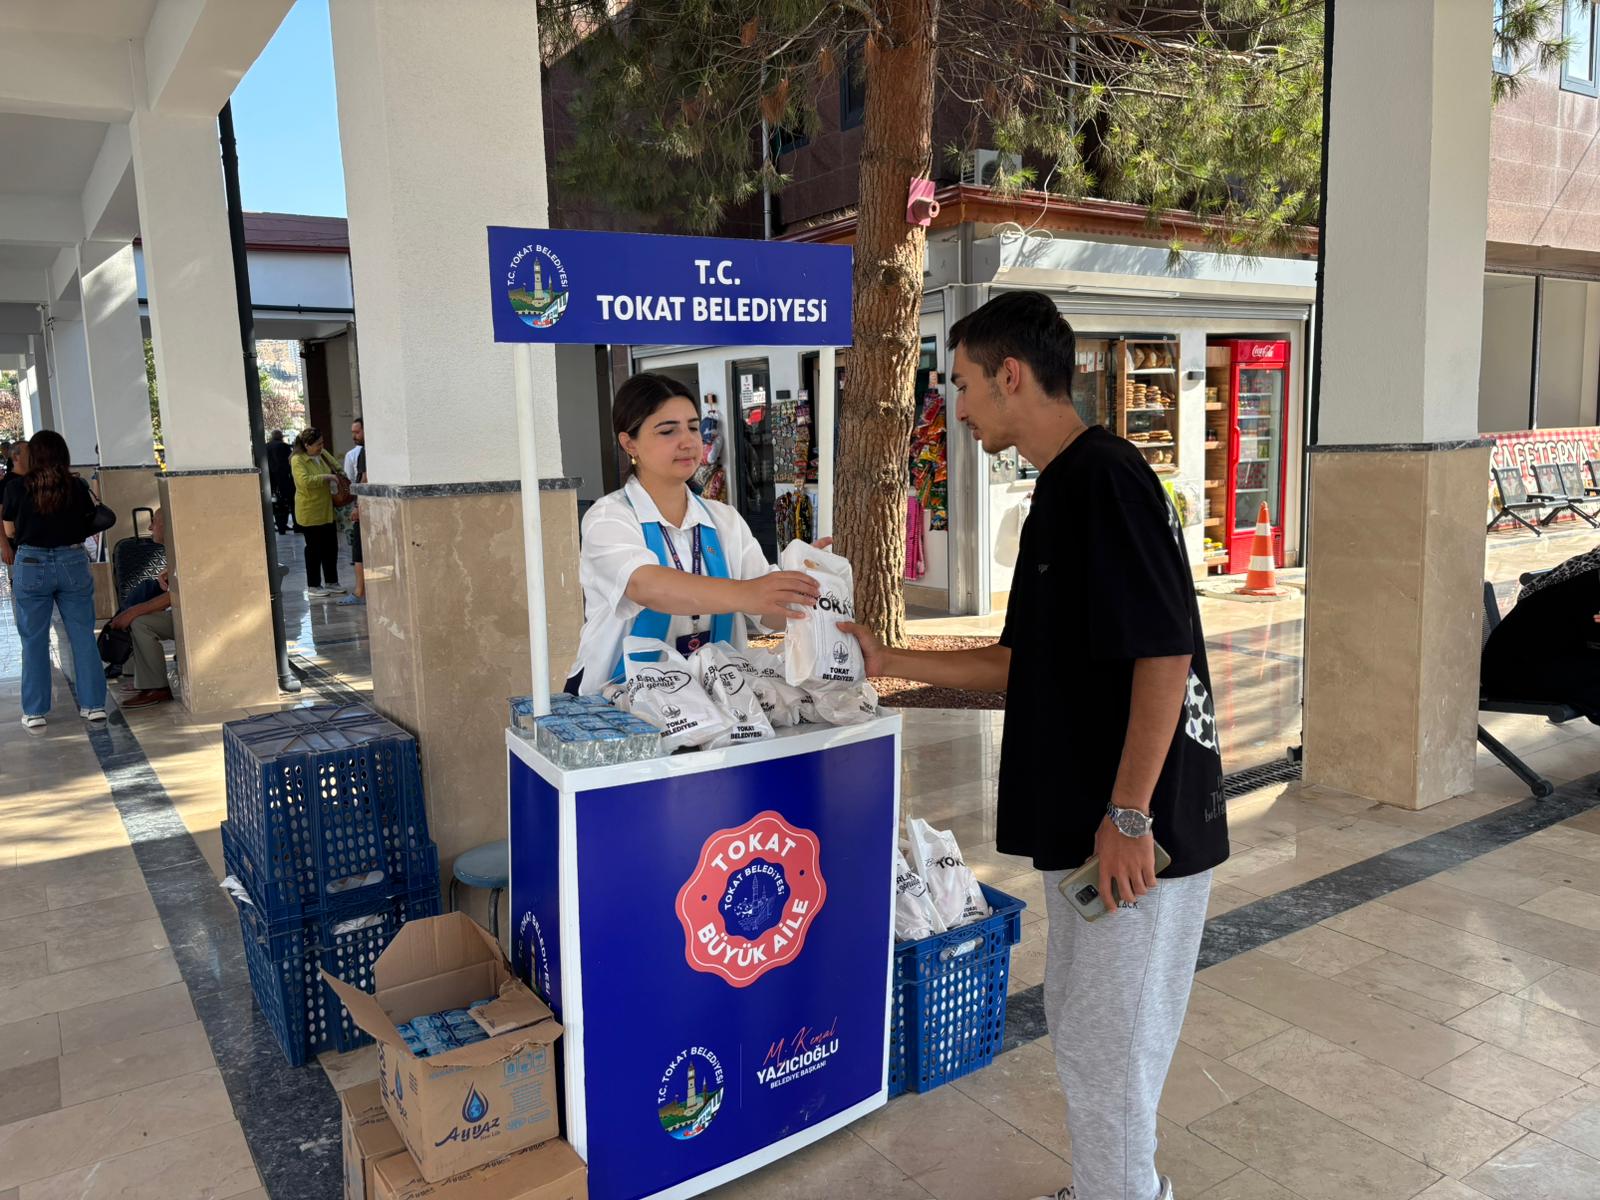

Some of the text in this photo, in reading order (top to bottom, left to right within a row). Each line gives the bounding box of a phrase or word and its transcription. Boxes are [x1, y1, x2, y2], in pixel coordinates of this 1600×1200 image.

[510, 244, 533, 268] TOKAT
[507, 270, 516, 286] T.C.
[695, 259, 741, 285] T.C.
[596, 294, 827, 322] TOKAT BELEDİYESİ
[829, 667, 850, 675] TOKAT
[666, 718, 688, 728] TOKAT
[710, 832, 797, 872] TOKAT
[724, 873, 745, 911] TOKAT
[1116, 899, 1138, 909] LACK
[696, 898, 809, 967] BÜYÜK AİLE
[662, 1049, 688, 1083] TOKAT
[756, 1038, 839, 1085] YAZICIOĞLU
[800, 1060, 827, 1077] BAŞKANI
[657, 1085, 668, 1104] T.C.
